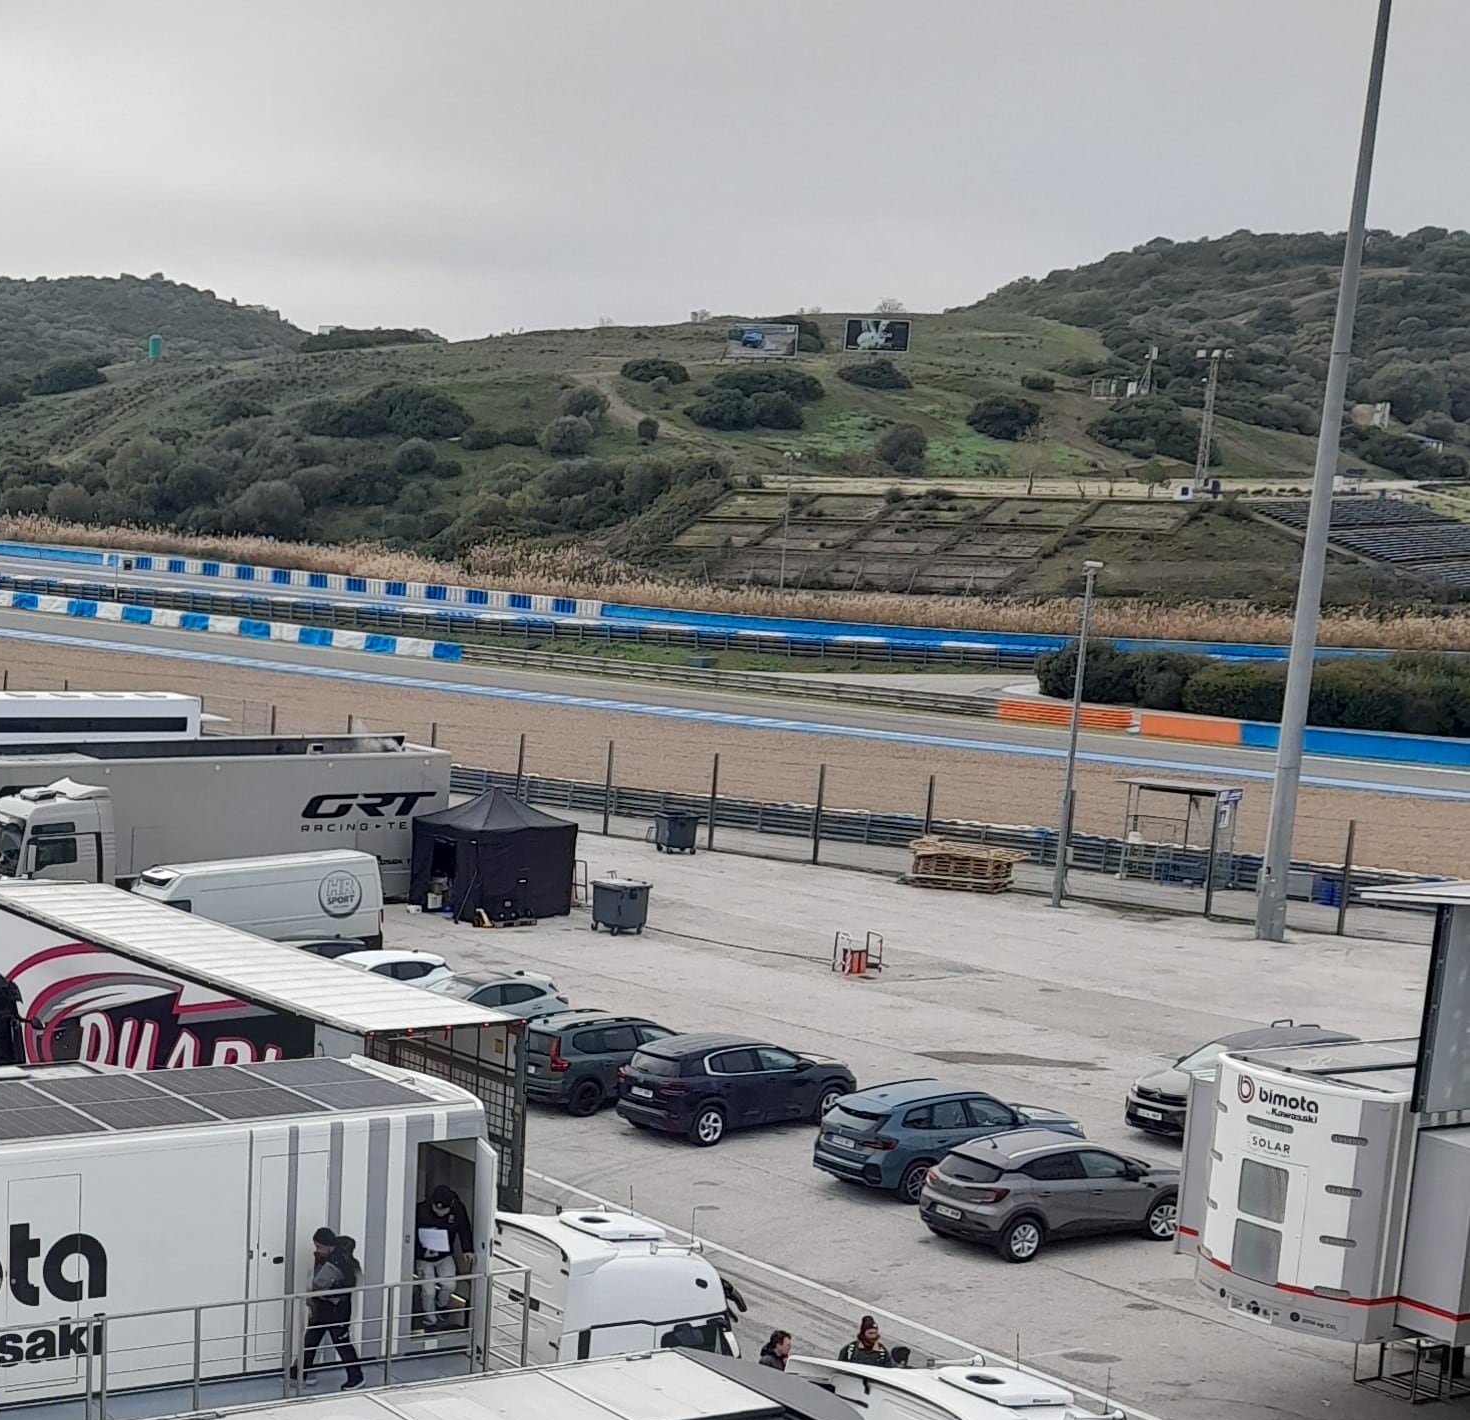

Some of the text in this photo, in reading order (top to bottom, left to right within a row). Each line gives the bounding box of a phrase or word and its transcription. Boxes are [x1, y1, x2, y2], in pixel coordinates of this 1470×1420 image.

[301, 791, 438, 819] GRT
[300, 821, 409, 833] RACING TE
[326, 877, 356, 898] HR
[327, 895, 355, 906] SPORT
[1258, 1086, 1319, 1114] bimota
[1251, 1135, 1291, 1154] SOLAR
